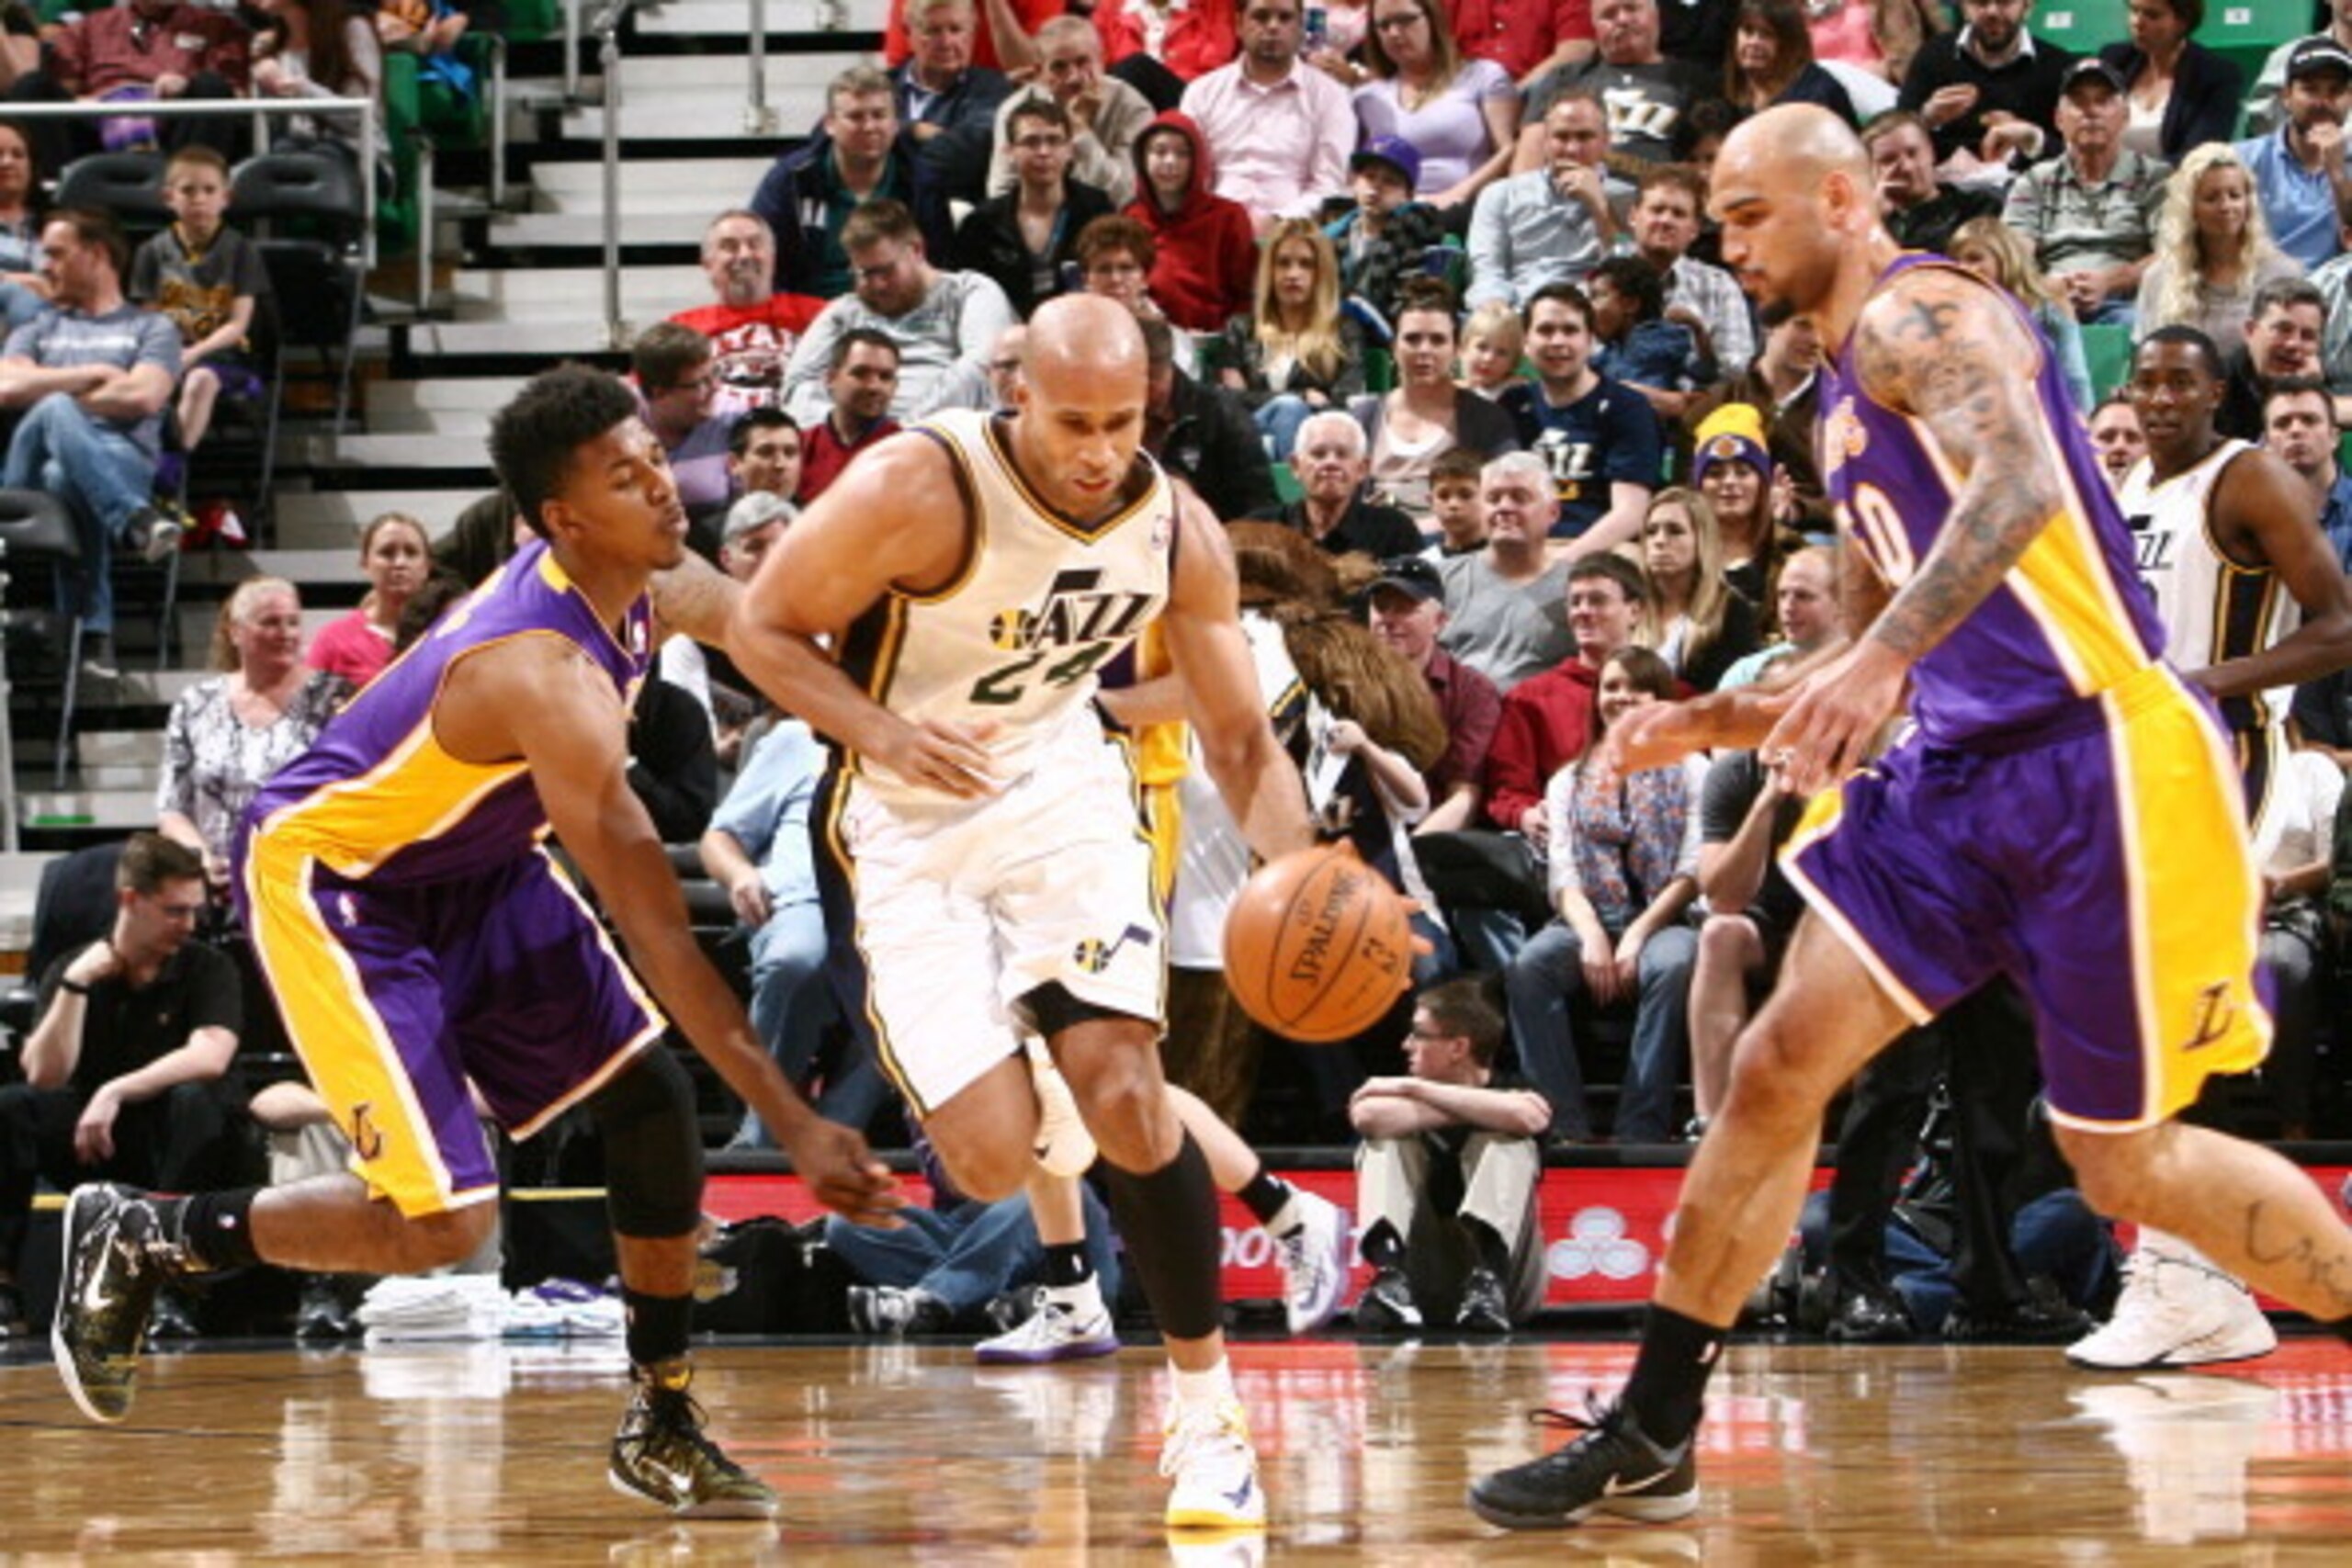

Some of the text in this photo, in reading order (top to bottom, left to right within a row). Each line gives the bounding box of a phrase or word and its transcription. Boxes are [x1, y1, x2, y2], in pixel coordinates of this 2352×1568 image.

[989, 569, 1158, 649] JAZZ
[968, 641, 1113, 705] 24
[1290, 870, 1356, 987] SPALDING
